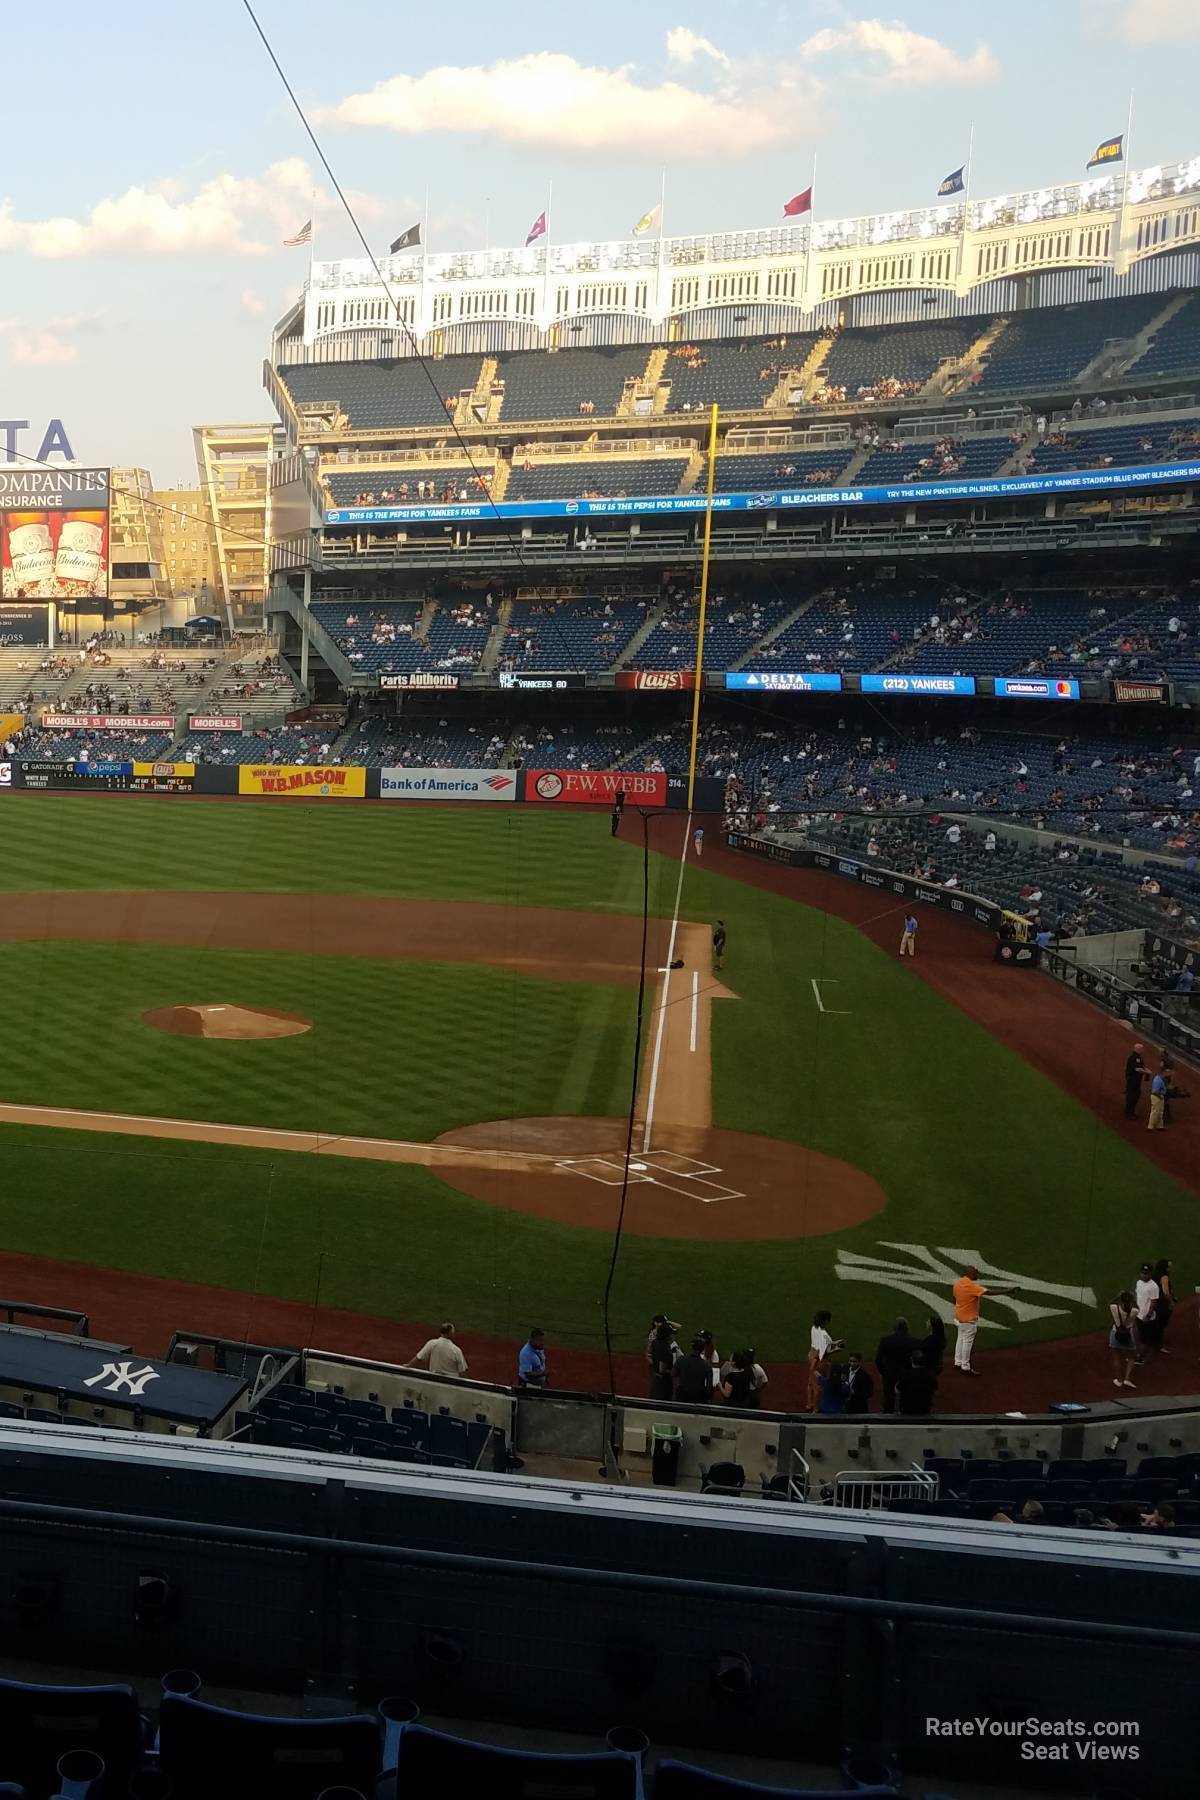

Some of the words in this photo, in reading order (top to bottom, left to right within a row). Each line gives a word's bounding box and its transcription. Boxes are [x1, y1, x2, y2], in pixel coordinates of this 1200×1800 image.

[887, 490, 900, 498] TRY
[901, 489, 914, 497] THE
[915, 489, 932, 497] NEW
[933, 487, 967, 496] PINSTRIPE
[1001, 481, 1043, 491] EXCLUSIVELY
[1054, 478, 1081, 487] YANKEE
[1082, 476, 1113, 485] STADIUM
[1114, 474, 1131, 483] BLUE
[1132, 473, 1150, 481] POINT
[1151, 469, 1187, 479] BLEACHERS
[781, 493, 839, 504] BLEACHERS
[841, 492, 863, 501] BAR
[589, 503, 607, 511] THIS
[634, 502, 655, 510] PEPSI
[657, 501, 673, 509] FOR
[674, 499, 708, 508] YANKEES
[710, 499, 731, 507] FANS
[349, 512, 365, 520] THIS
[374, 511, 388, 519] THE
[410, 510, 425, 518] FOR
[426, 508, 460, 517] YANKEES
[460, 508, 481, 516] FANS
[380, 675, 407, 686] Parts
[409, 673, 460, 686] Authority
[519, 680, 552, 688] YANKEES
[760, 674, 804, 683] DELTA
[882, 678, 909, 690] (212)
[911, 679, 955, 690] YANKEES
[1007, 683, 1048, 693] yankees.com
[46, 718, 88, 726] MODELL'S
[105, 718, 170, 727] MODELLS.com
[195, 719, 237, 728] MODELL'S
[99, 763, 121, 772] pepsi
[252, 769, 266, 777] WHO
[381, 778, 411, 790] Bank
[413, 778, 427, 790] of
[427, 779, 479, 791] America
[566, 775, 598, 791] F.W.
[602, 776, 657, 794] WEBB
[668, 779, 682, 787] 314
